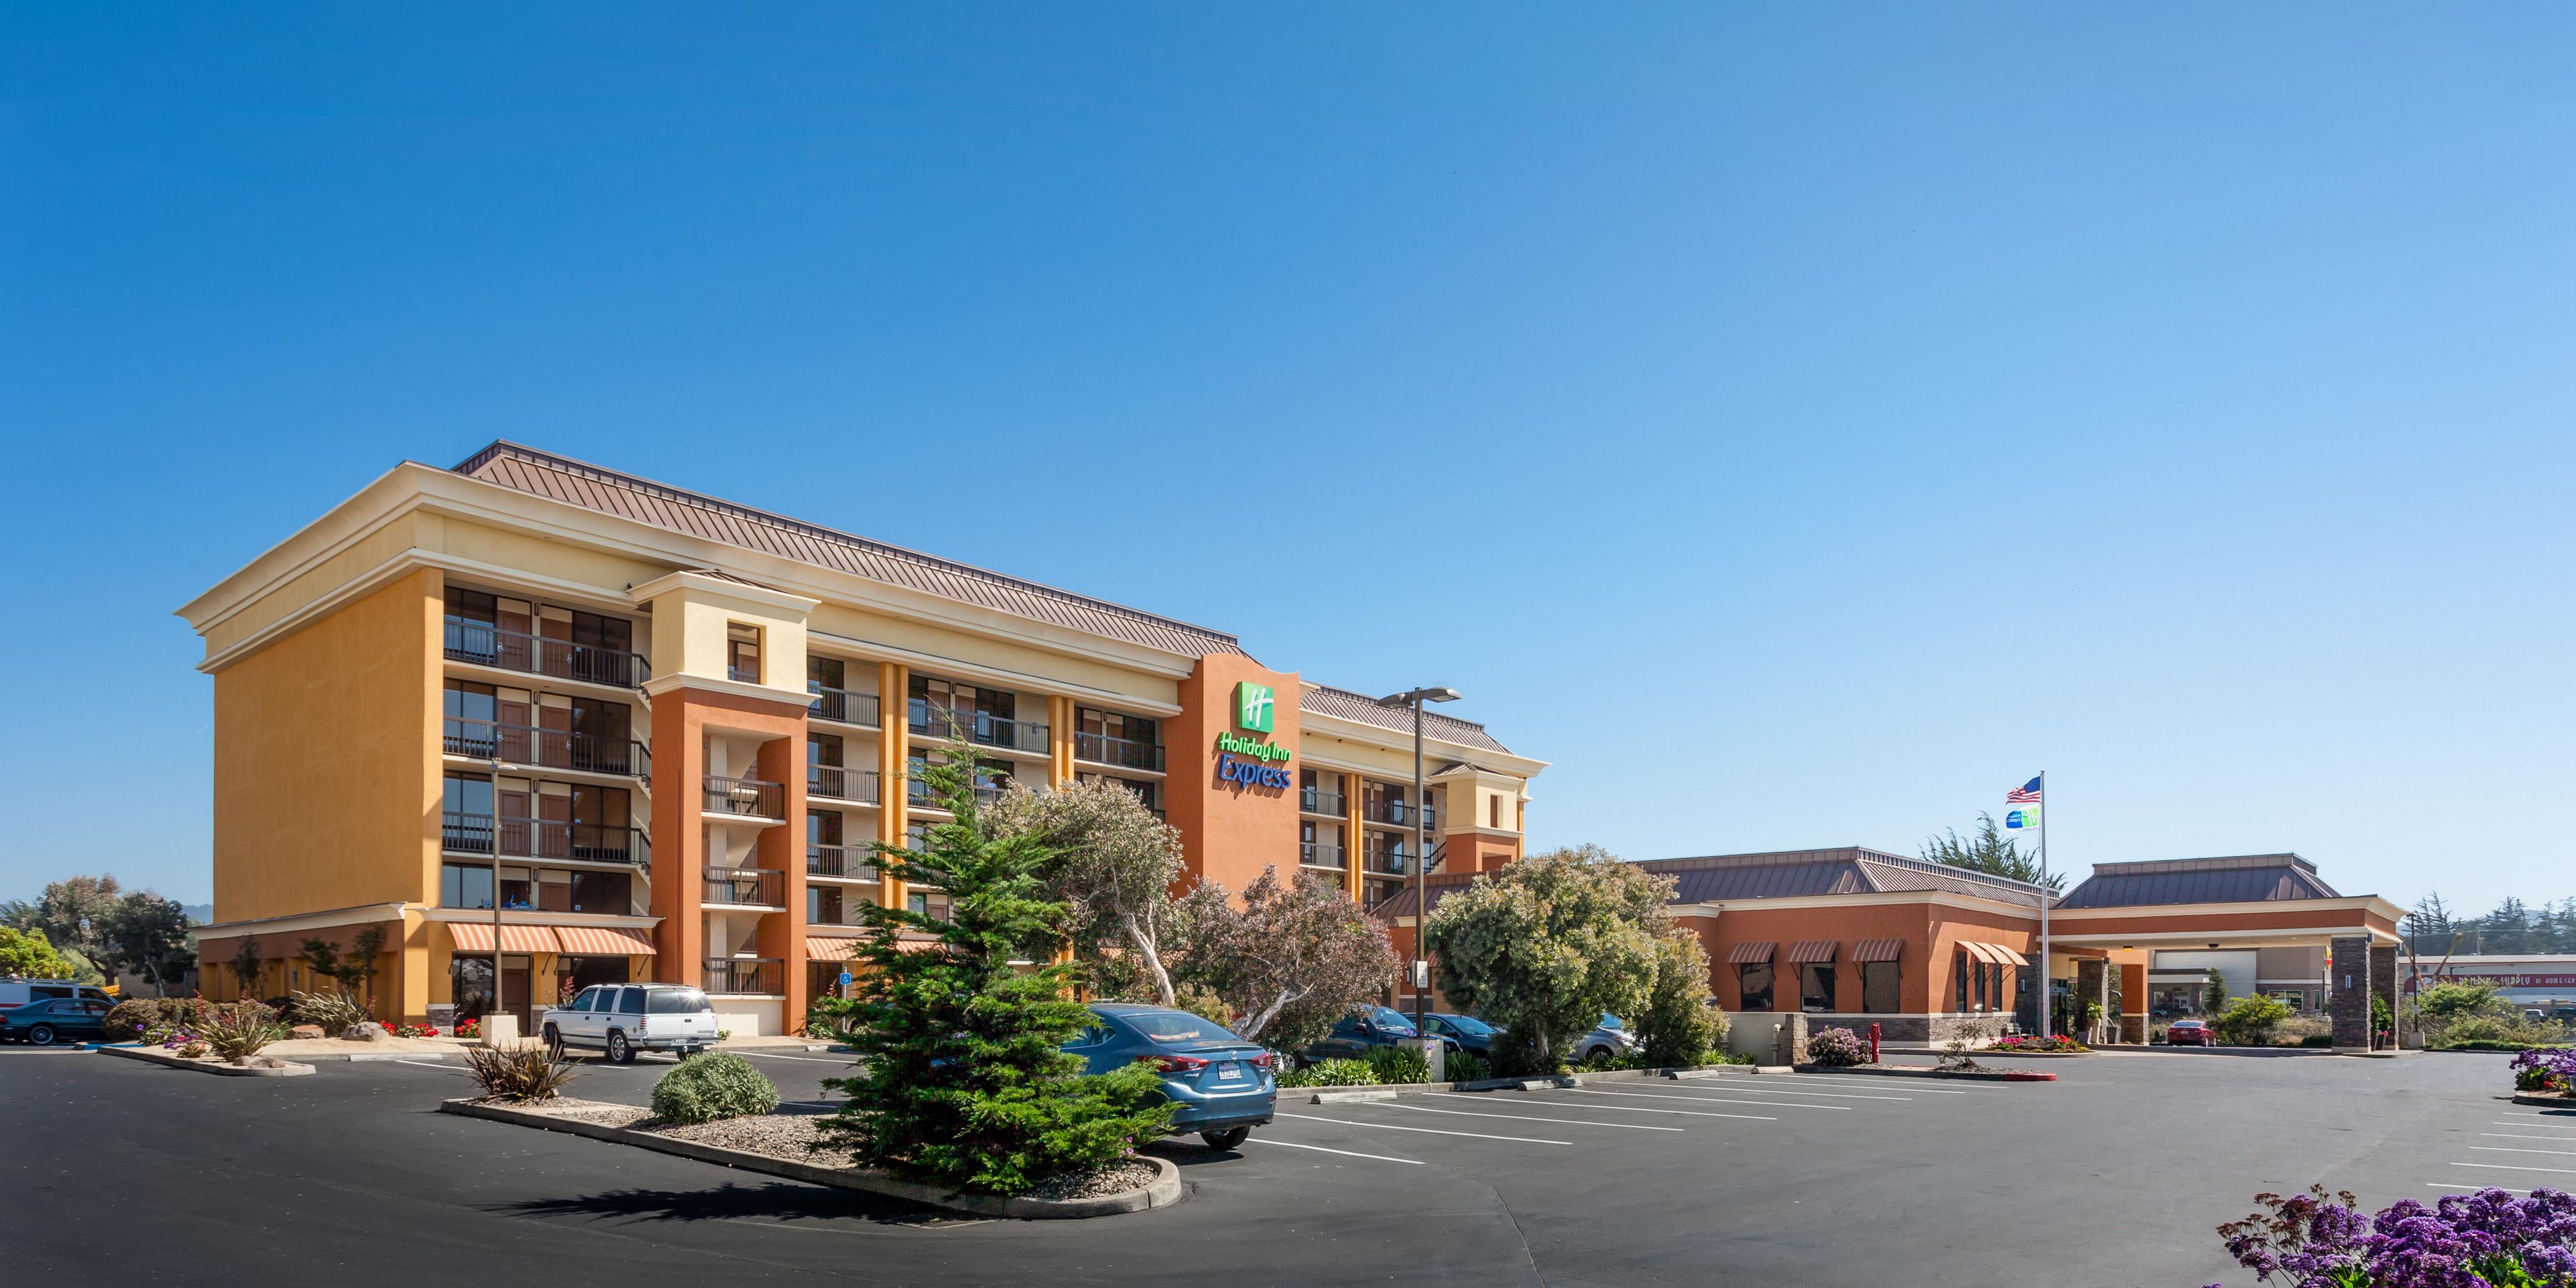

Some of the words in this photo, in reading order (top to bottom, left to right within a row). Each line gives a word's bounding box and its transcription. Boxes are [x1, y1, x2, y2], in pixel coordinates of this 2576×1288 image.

[1245, 688, 1274, 728] H
[1219, 731, 1271, 762] Holiday
[1273, 742, 1292, 762] Inn
[1218, 753, 1292, 789] Express
[2501, 976, 2530, 985] SUPPLY
